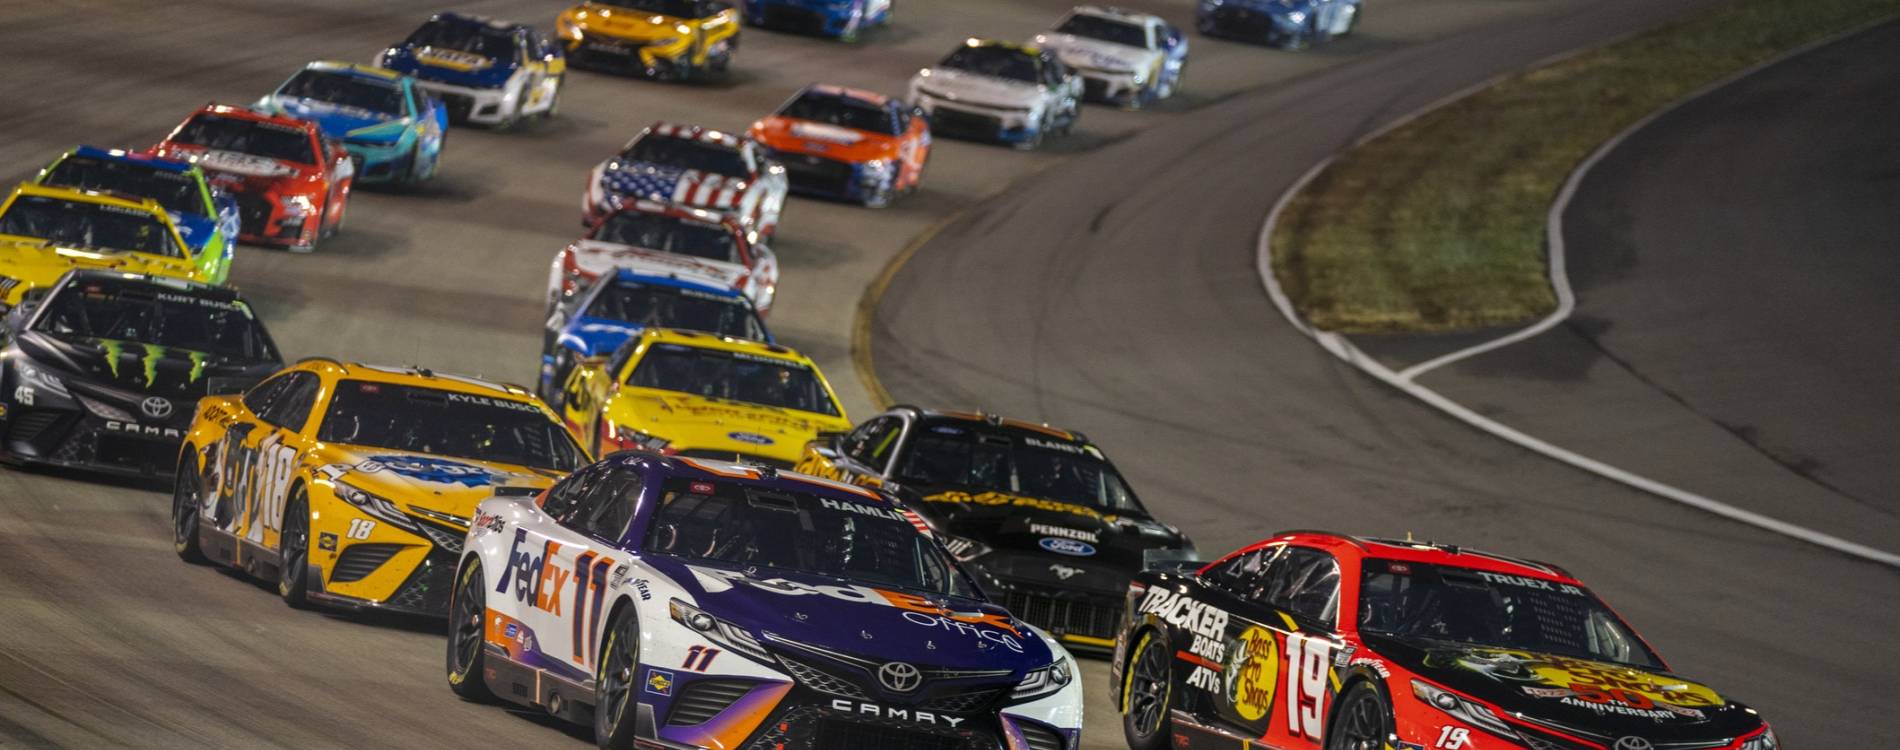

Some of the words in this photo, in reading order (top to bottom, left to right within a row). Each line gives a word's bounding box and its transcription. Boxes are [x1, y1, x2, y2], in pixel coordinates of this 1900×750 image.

[157, 293, 197, 305] KURT
[15, 387, 34, 404] 45
[448, 393, 492, 407] KYLE
[1025, 437, 1084, 454] BLANEY
[347, 518, 376, 540] 18
[1030, 523, 1099, 543] PENNZOIL
[1050, 538, 1086, 555] Ford
[495, 527, 570, 616] FedEx
[1477, 571, 1555, 592] TRUEX
[1560, 584, 1584, 597] JR
[572, 550, 615, 673] 11
[1138, 584, 1229, 641] TRACKER
[902, 611, 1024, 654] Office
[680, 645, 721, 673] 11
[1189, 634, 1225, 663] BOATS
[1186, 666, 1221, 695] ATVs
[1286, 632, 1331, 743] 19
[1242, 678, 1269, 715] Shops
[1560, 697, 1677, 720] ANNIVERSARY
[831, 698, 965, 729] CAMRY
[1435, 725, 1471, 750] 19
